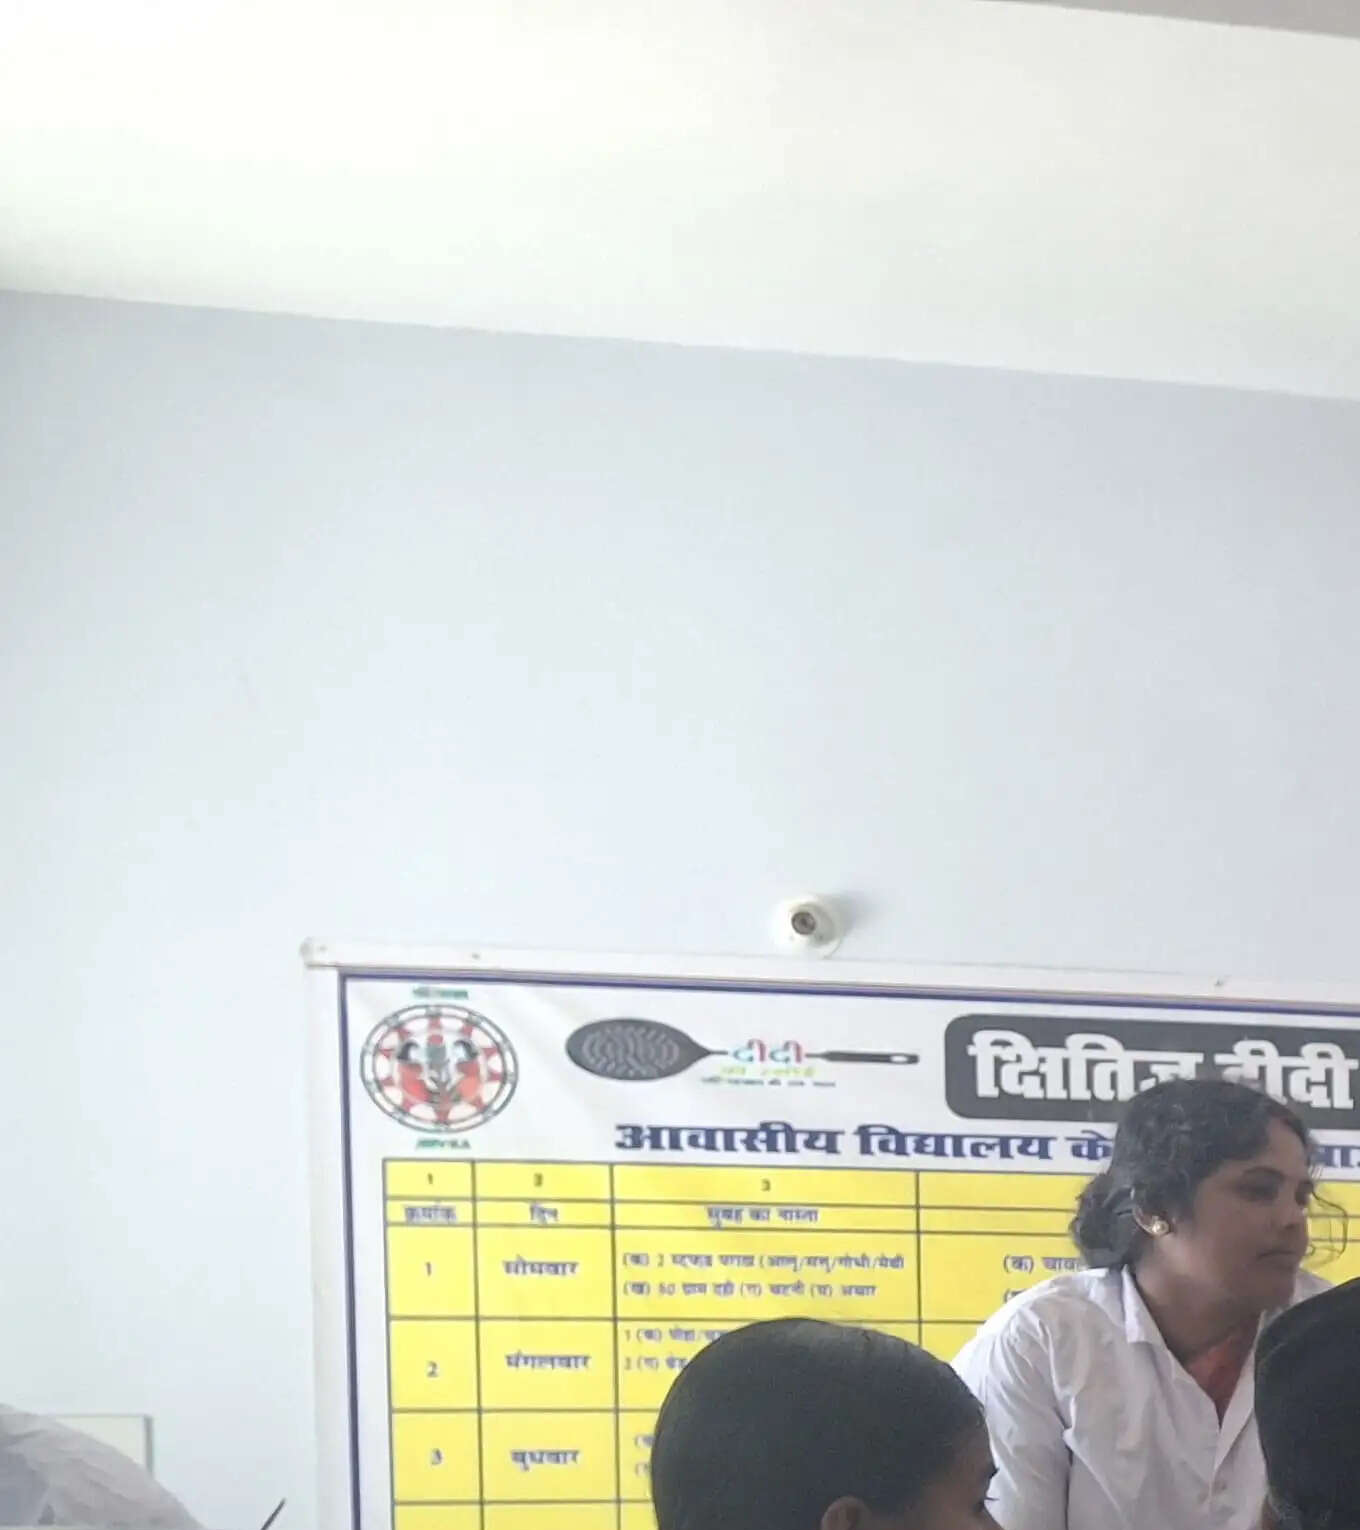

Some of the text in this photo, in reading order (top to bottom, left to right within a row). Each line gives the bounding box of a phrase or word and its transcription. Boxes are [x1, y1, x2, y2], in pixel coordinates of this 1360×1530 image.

[967, 1030, 1203, 1100] क्षितिज
[614, 1121, 845, 1154] आवासीय
[854, 1125, 1053, 1160] विद्यालय
[1065, 1130, 1112, 1158] के
[1041, 1256, 1080, 1272] चाव
[427, 1362, 438, 1377] 2
[431, 1449, 442, 1464] 3
